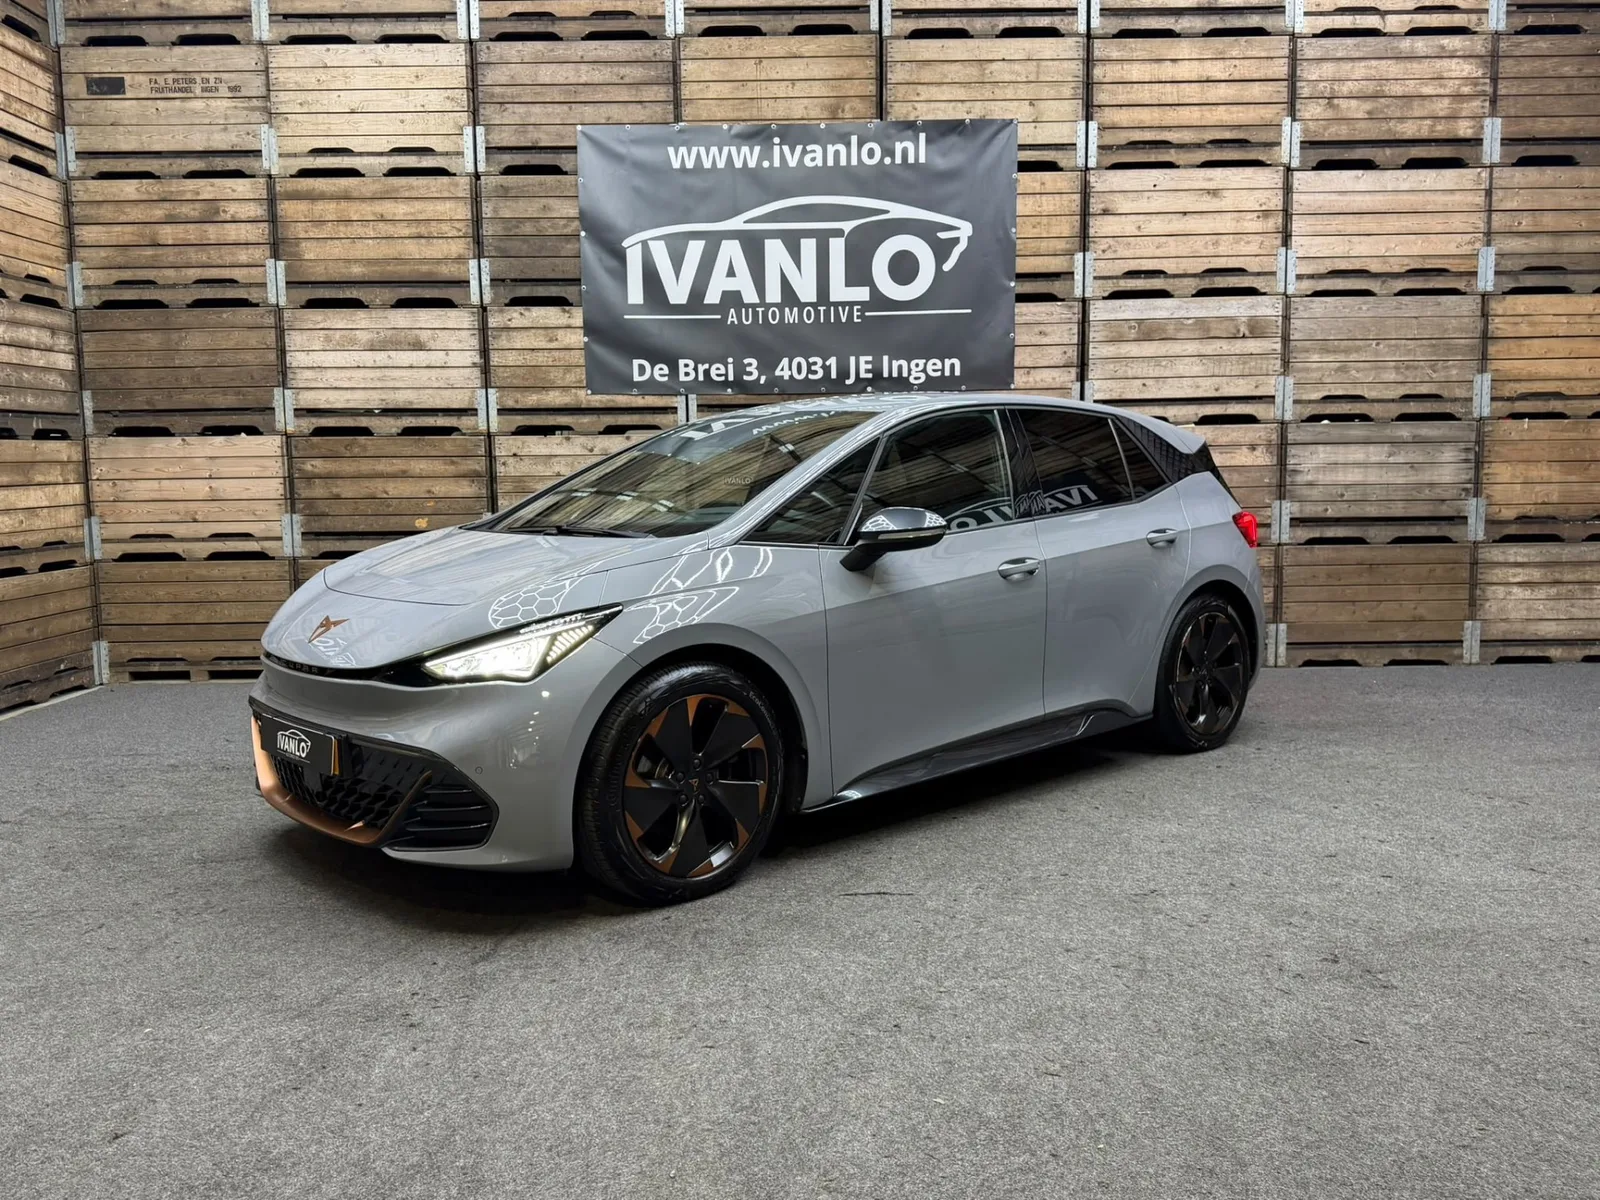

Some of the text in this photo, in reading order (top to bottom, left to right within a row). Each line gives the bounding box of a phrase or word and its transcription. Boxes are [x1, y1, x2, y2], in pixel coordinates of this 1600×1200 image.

[150, 85, 193, 94] FRUITHANDEL
[172, 77, 197, 85] PETERS
[201, 76, 210, 84] EN
[667, 133, 926, 169] www.ivanlo.nl
[625, 234, 936, 305] IVANLO
[726, 305, 862, 325] AUTOMOTIVE
[632, 354, 961, 385] De Brei 3, 4031 JE Ingen
[277, 733, 307, 758] IVANLO
